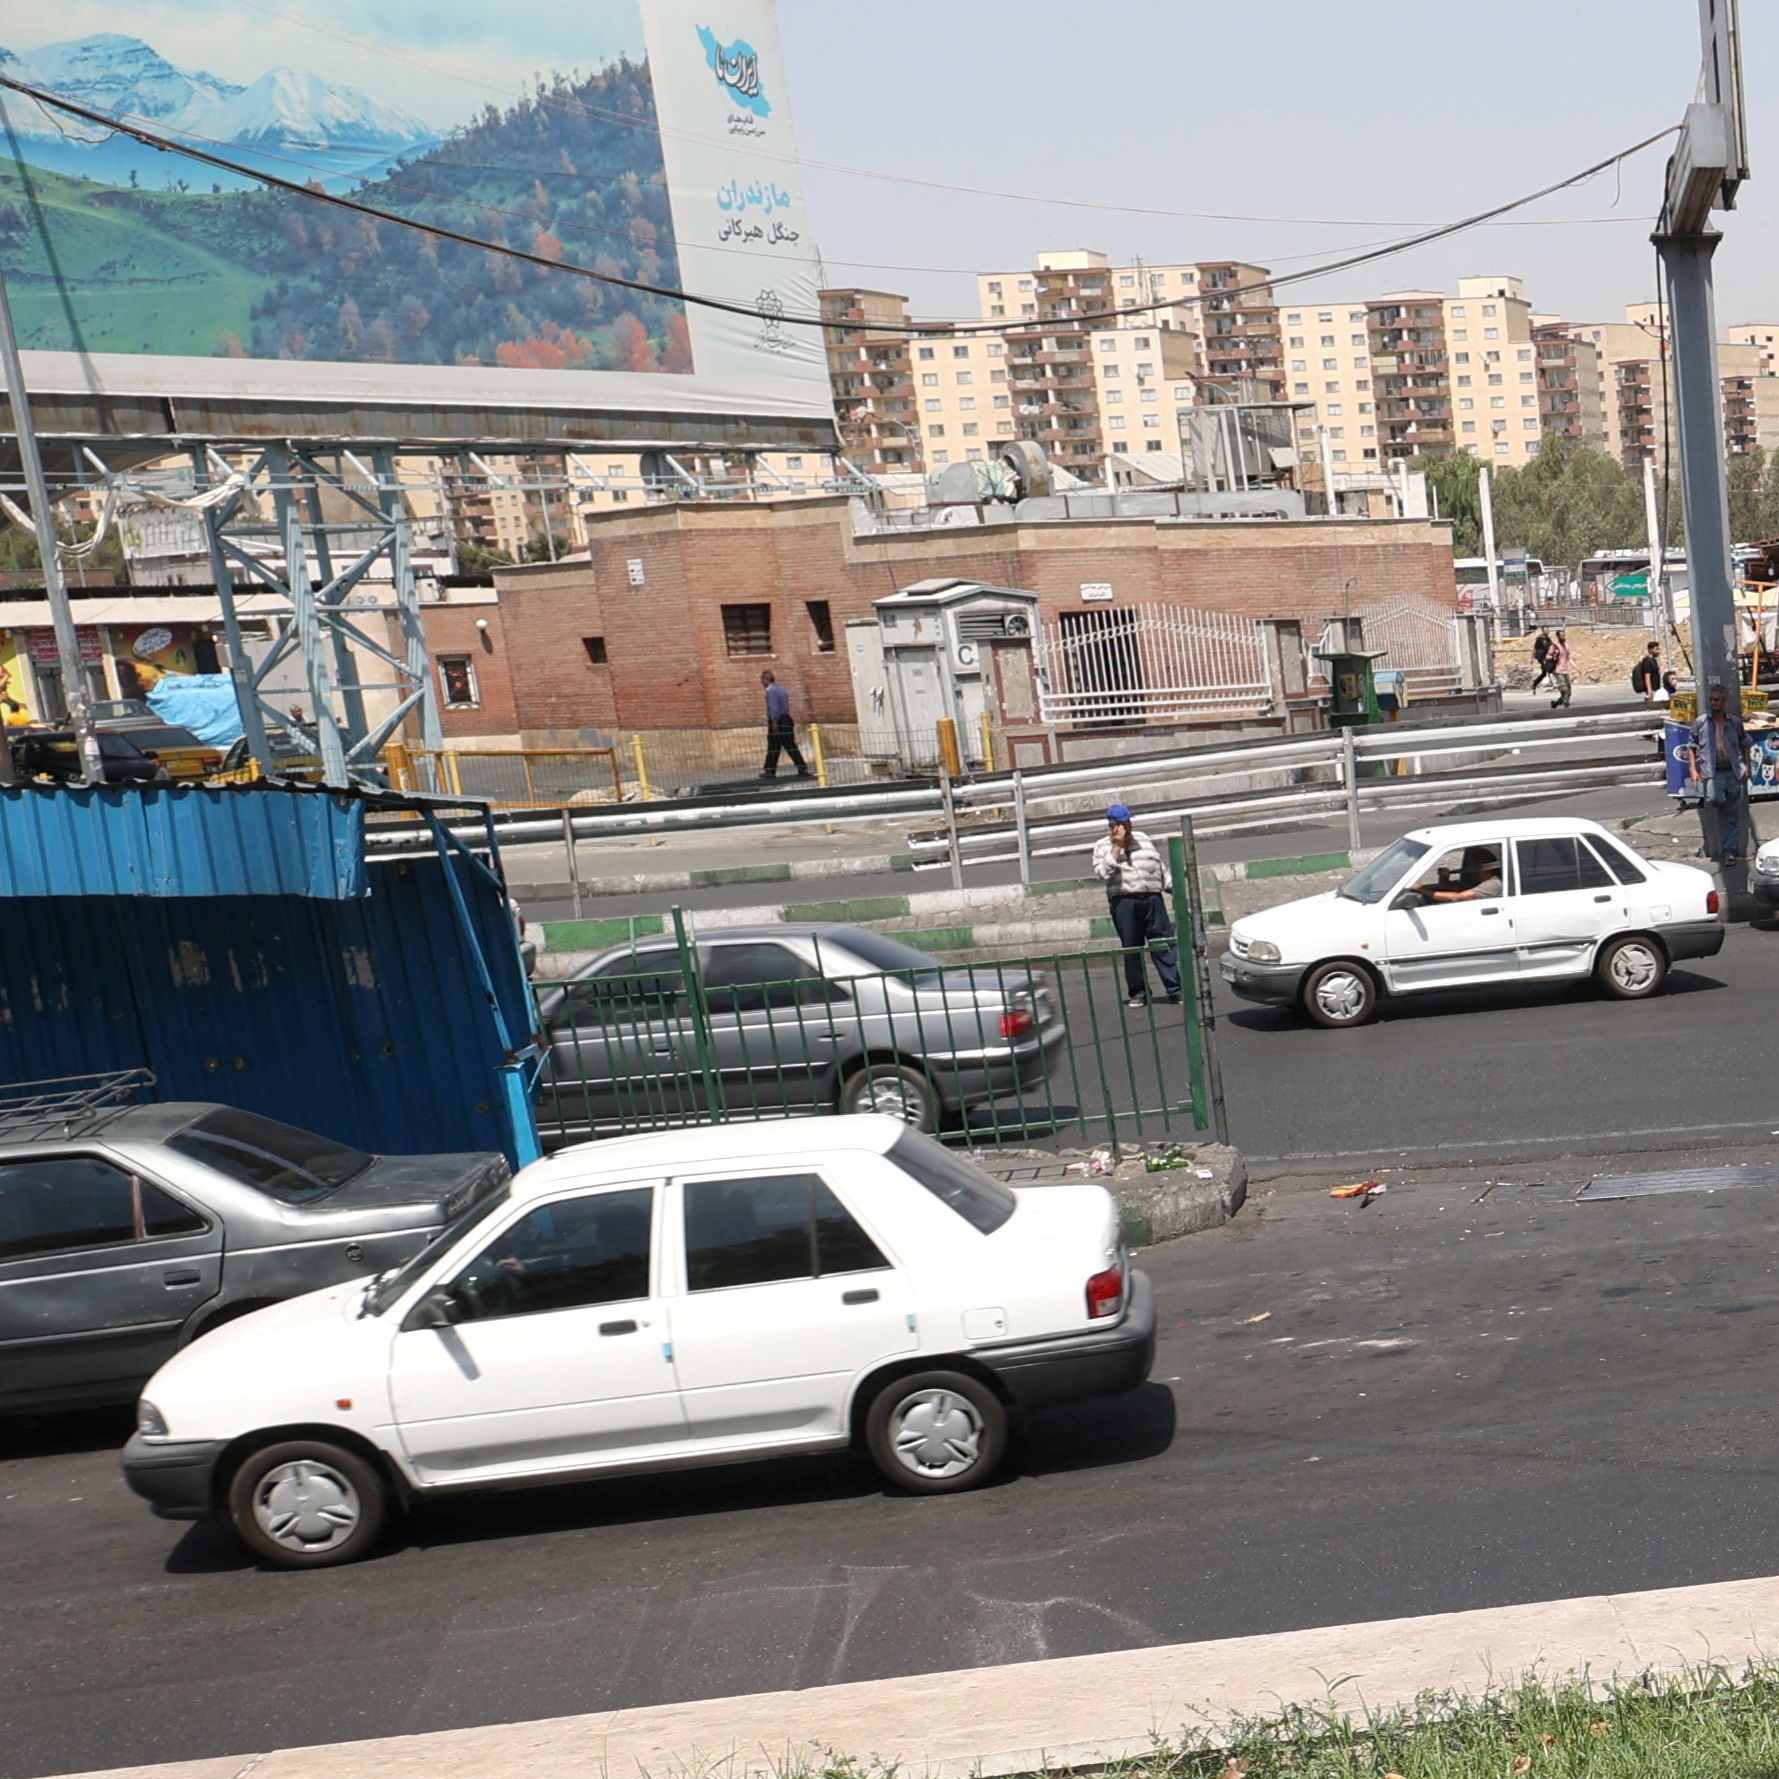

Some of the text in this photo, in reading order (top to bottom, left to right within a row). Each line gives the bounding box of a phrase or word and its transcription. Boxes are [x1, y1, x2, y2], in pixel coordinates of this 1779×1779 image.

[716, 178, 791, 215] مازندران
[718, 218, 800, 247] جنگل هیرکانی
[957, 645, 975, 666] C
